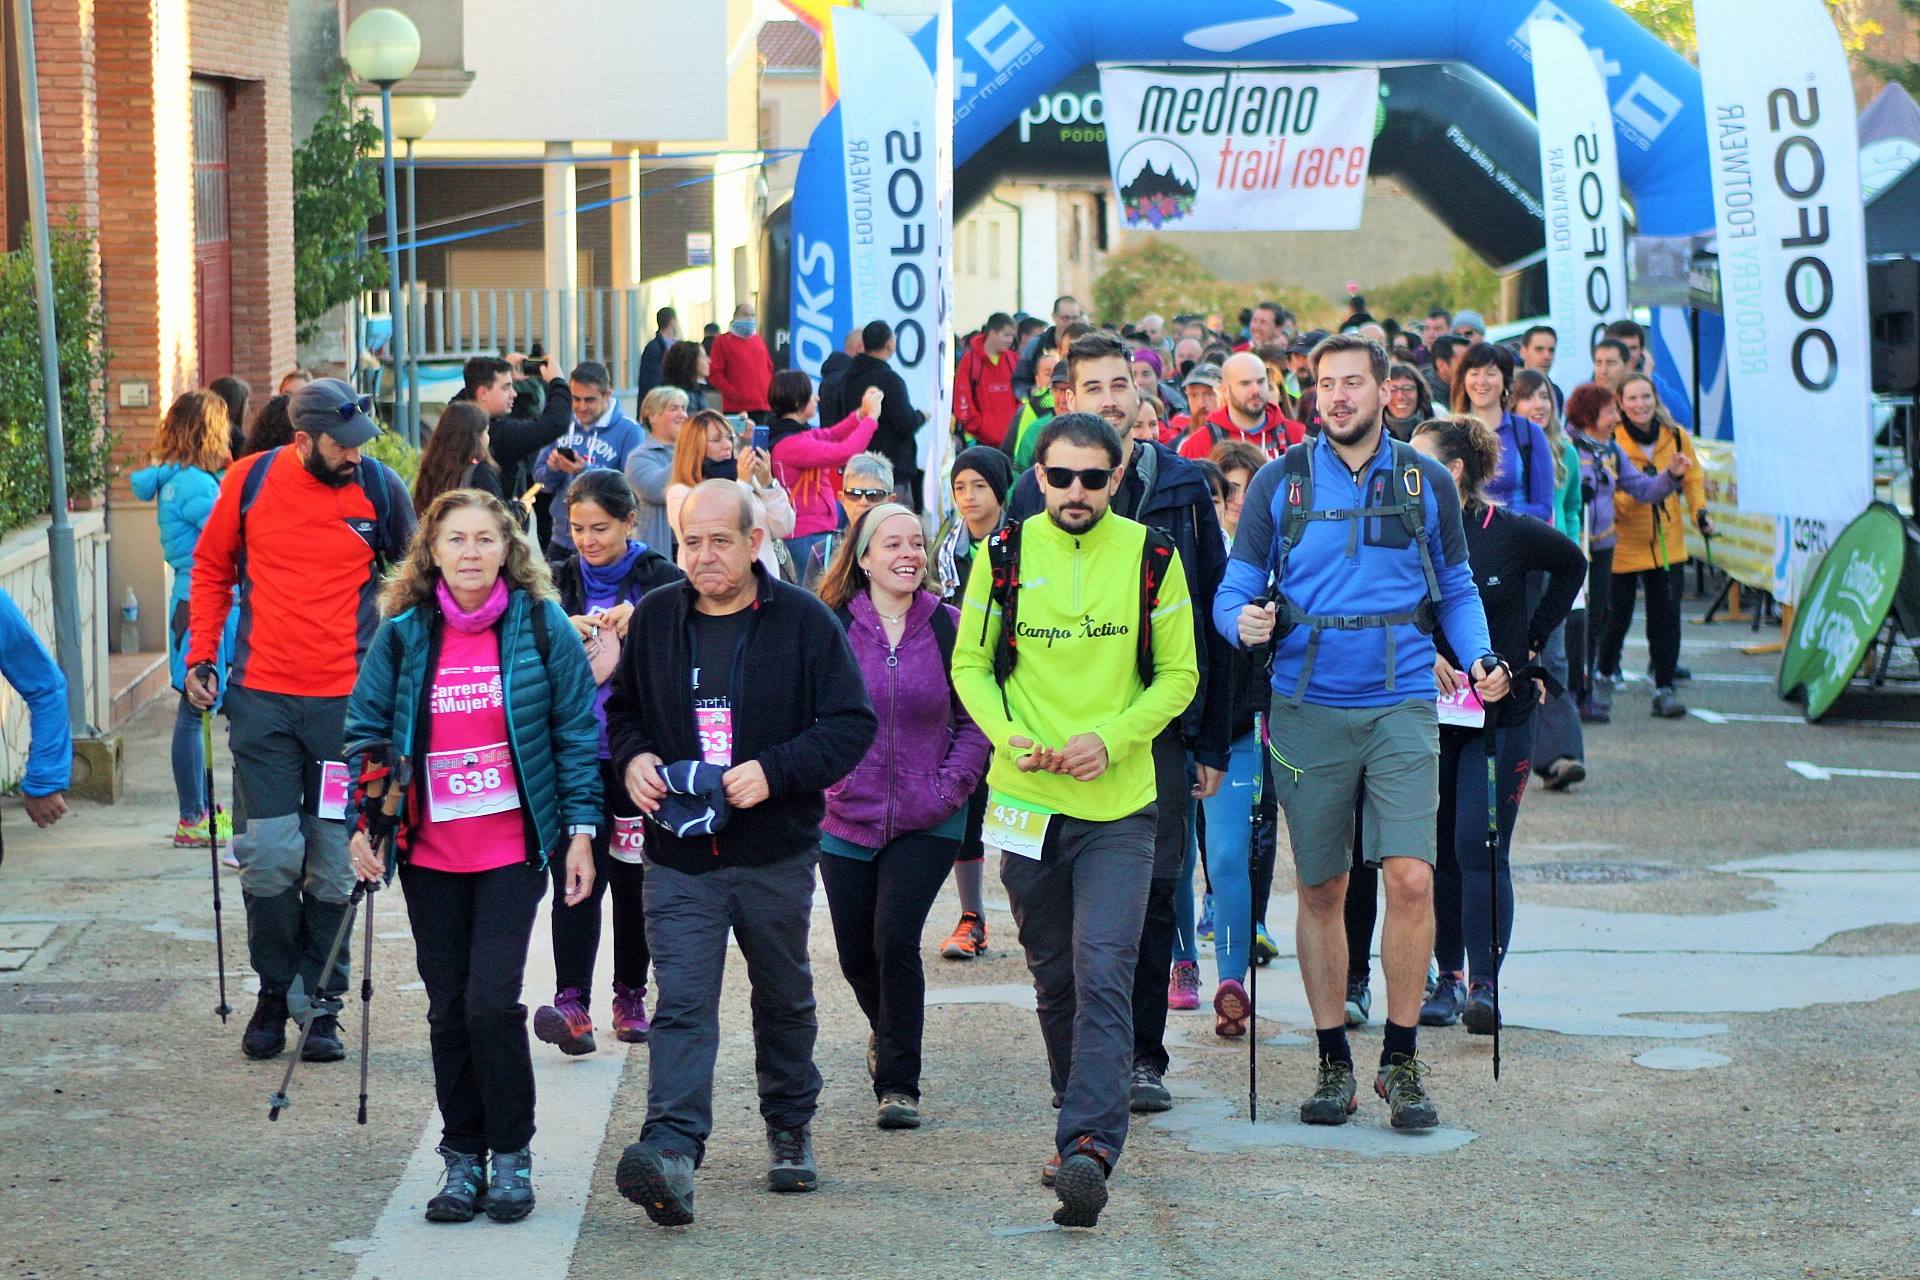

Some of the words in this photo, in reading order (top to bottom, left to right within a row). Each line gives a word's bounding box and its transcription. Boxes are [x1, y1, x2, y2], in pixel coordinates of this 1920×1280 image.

[1137, 71, 1319, 137] medrano
[1216, 137, 1287, 192] trail
[1291, 145, 1367, 189] race
[1446, 124, 1472, 153] Pisa
[1495, 169, 1519, 194] vive
[795, 233, 835, 390] OKS
[1017, 621, 1072, 648] Campo
[1079, 615, 1129, 638] Activo
[440, 696, 489, 714] Mujer
[449, 767, 502, 795] 638
[993, 805, 1030, 829] 431
